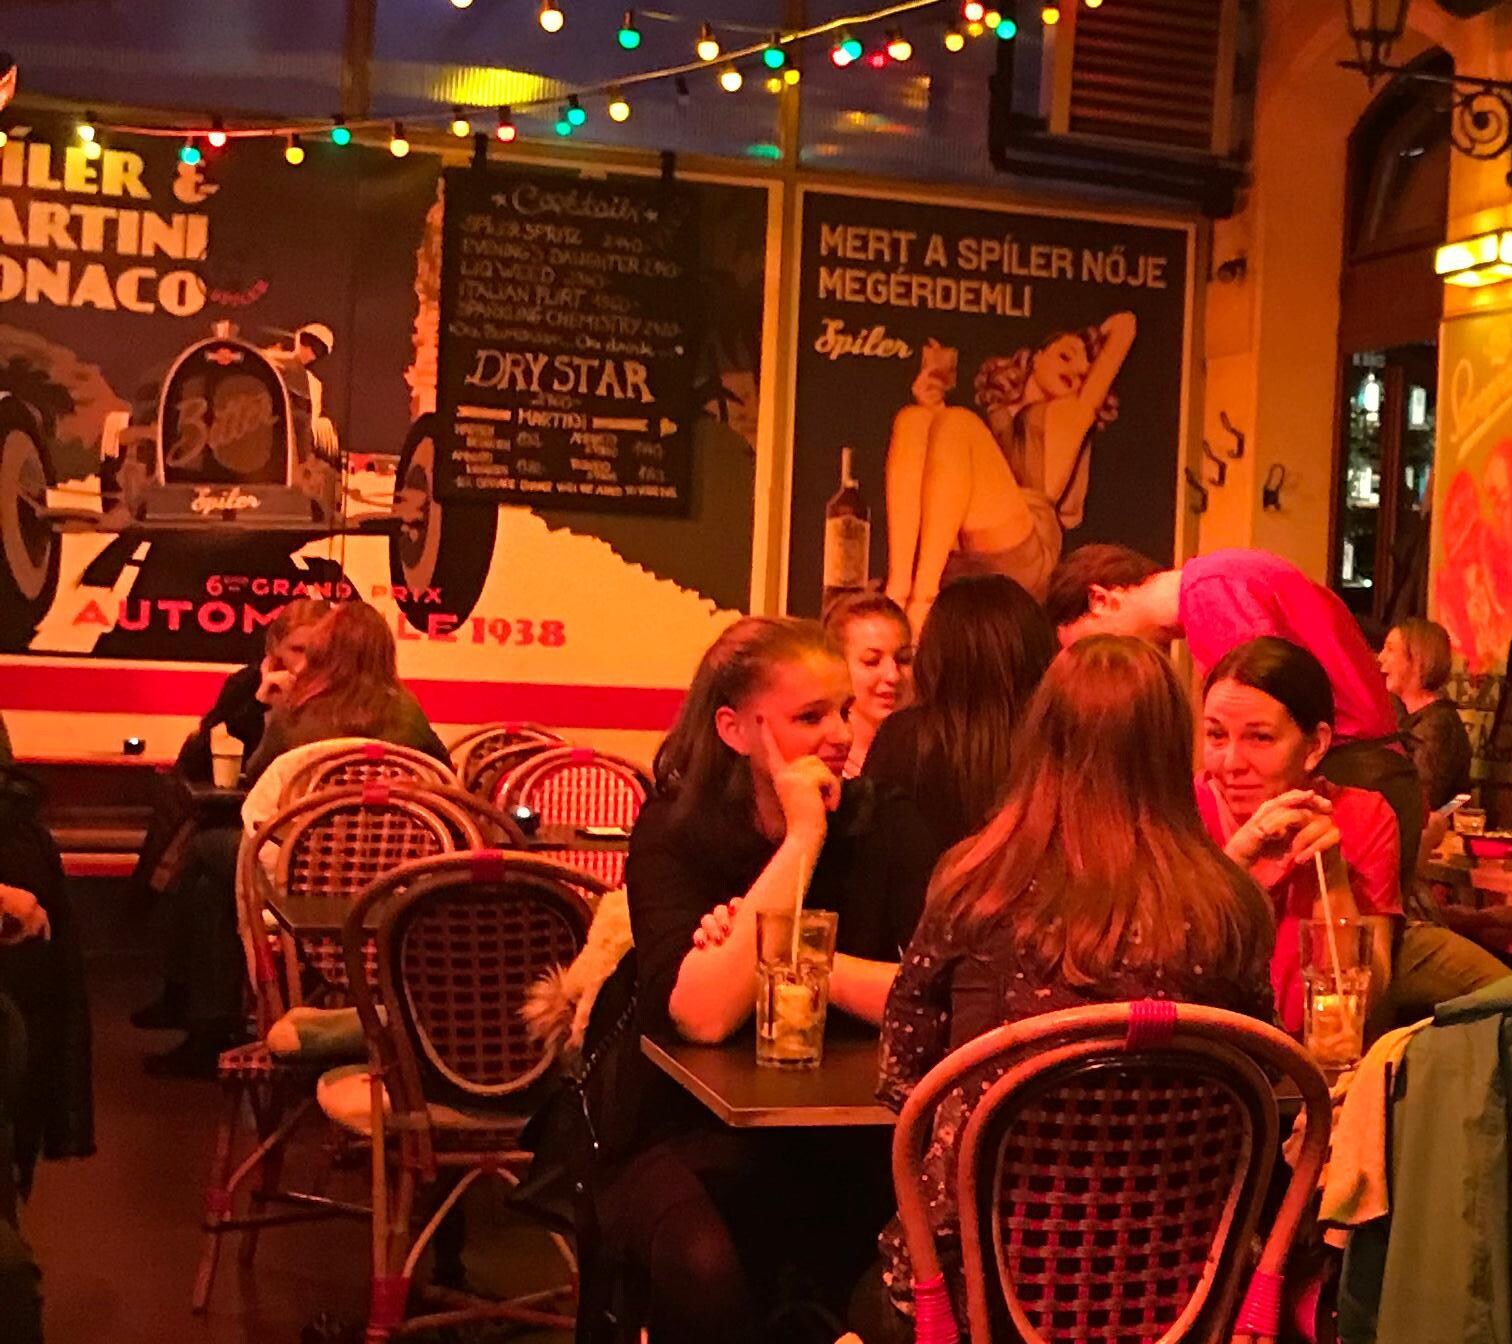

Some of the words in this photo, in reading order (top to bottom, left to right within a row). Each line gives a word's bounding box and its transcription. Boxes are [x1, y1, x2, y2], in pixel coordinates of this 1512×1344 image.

[820, 223, 917, 264] MERT
[925, 234, 947, 268] A
[958, 233, 1073, 280] SPÍLER
[1082, 245, 1168, 289] NŐJE
[818, 266, 1032, 318] MEGÉRDEMLI
[464, 349, 549, 391] DRY
[553, 355, 656, 403] STAR
[252, 577, 352, 599] GRAND
[371, 585, 442, 604] PRIX
[72, 599, 458, 643] AUTOMLE
[471, 617, 566, 647] 1938
